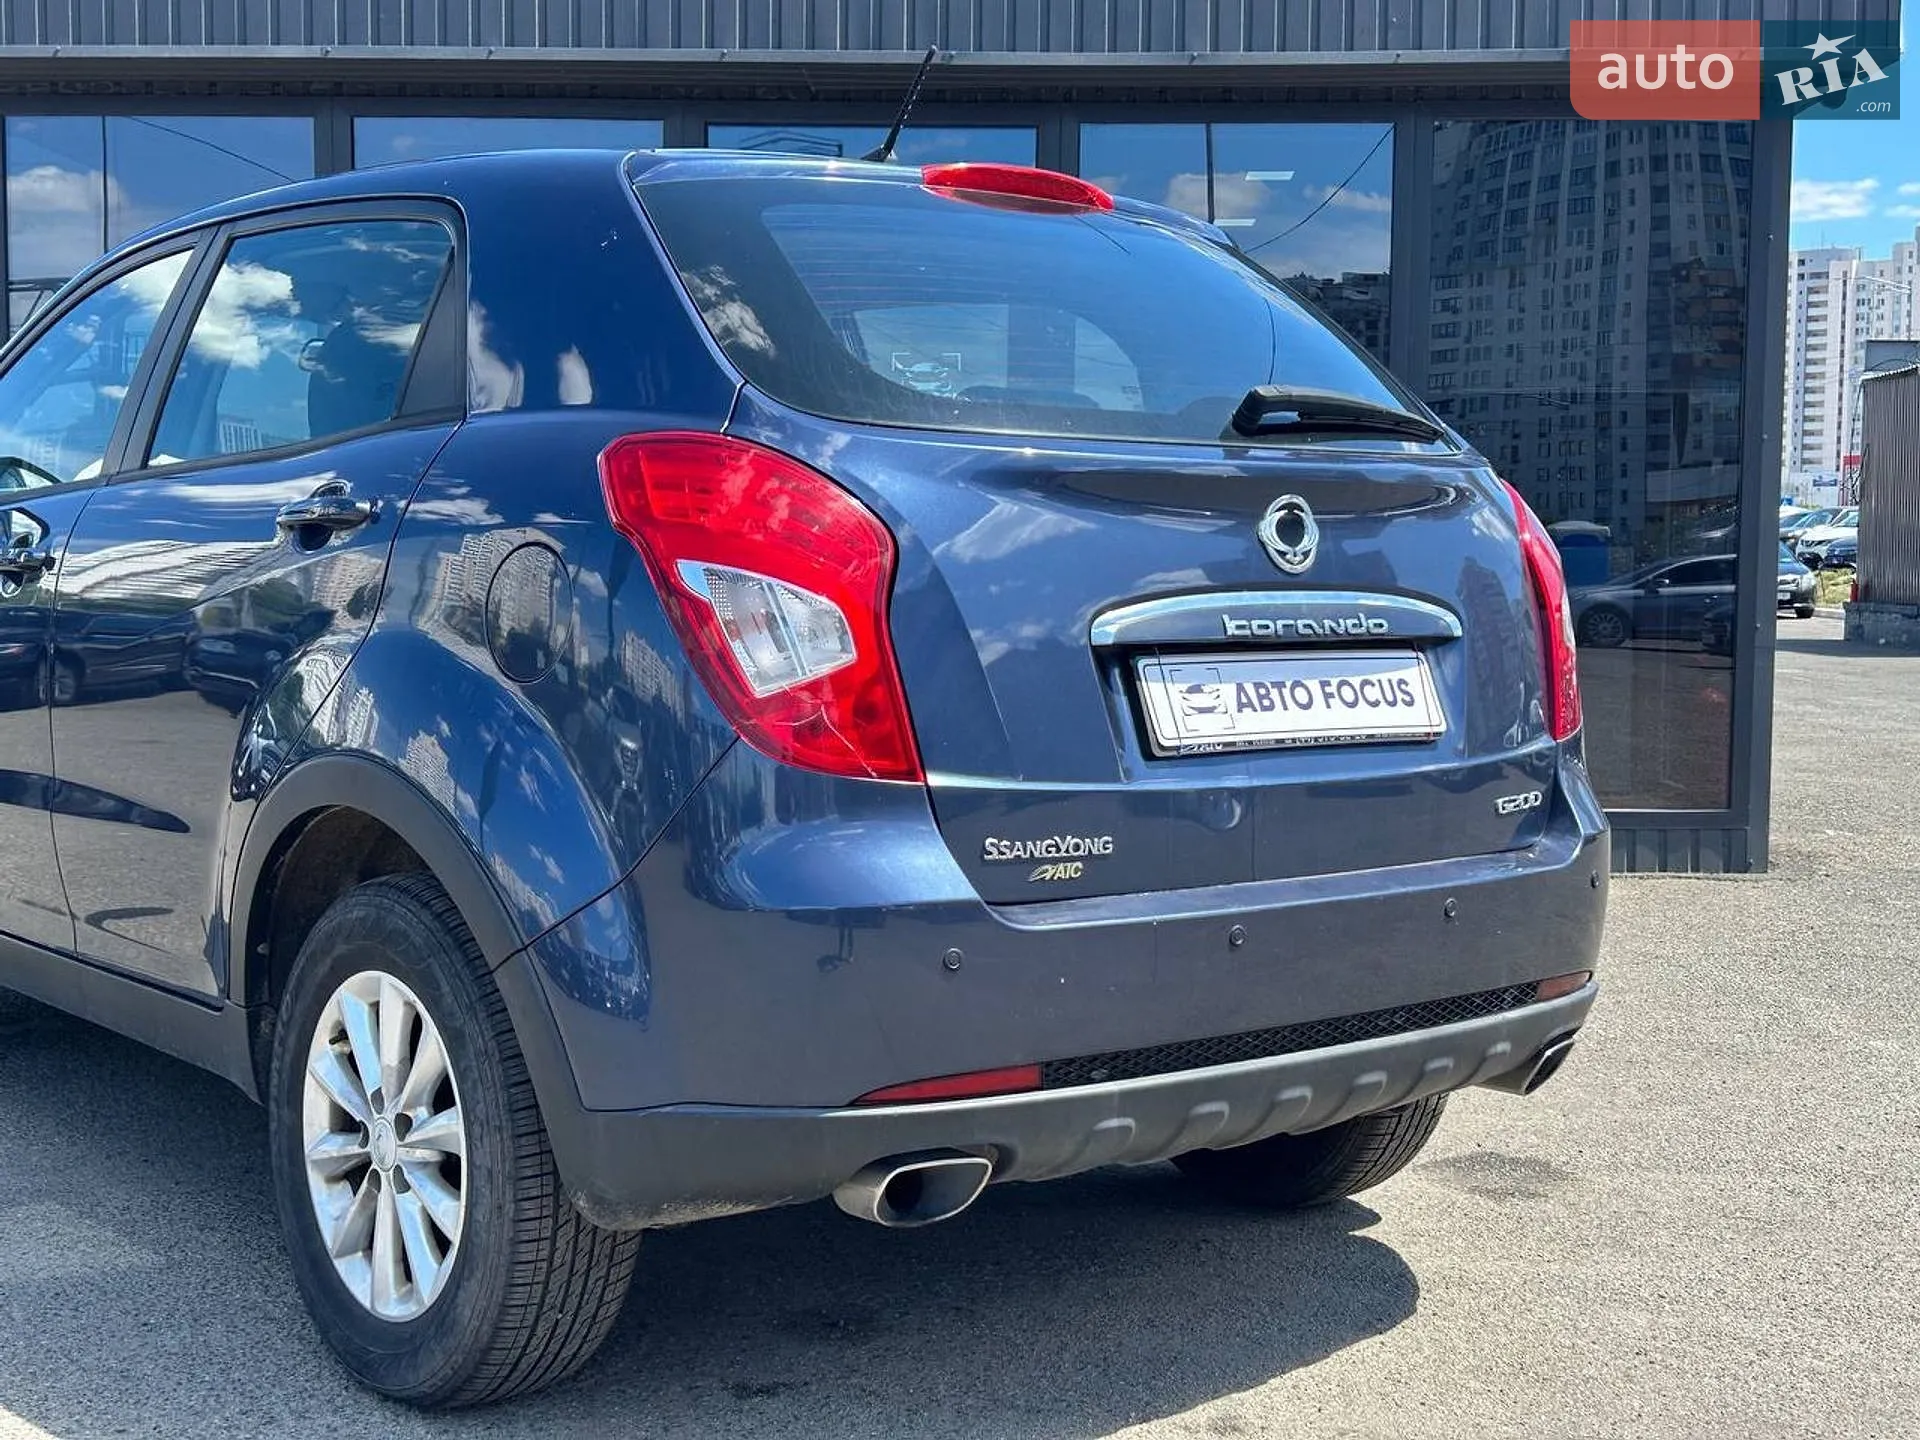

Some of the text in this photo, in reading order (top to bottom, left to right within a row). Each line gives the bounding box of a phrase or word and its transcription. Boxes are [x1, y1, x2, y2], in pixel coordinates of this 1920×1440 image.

[1222, 612, 1389, 636] korando
[1235, 677, 1415, 714] АВТО FOCUS
[1494, 791, 1542, 814] G200
